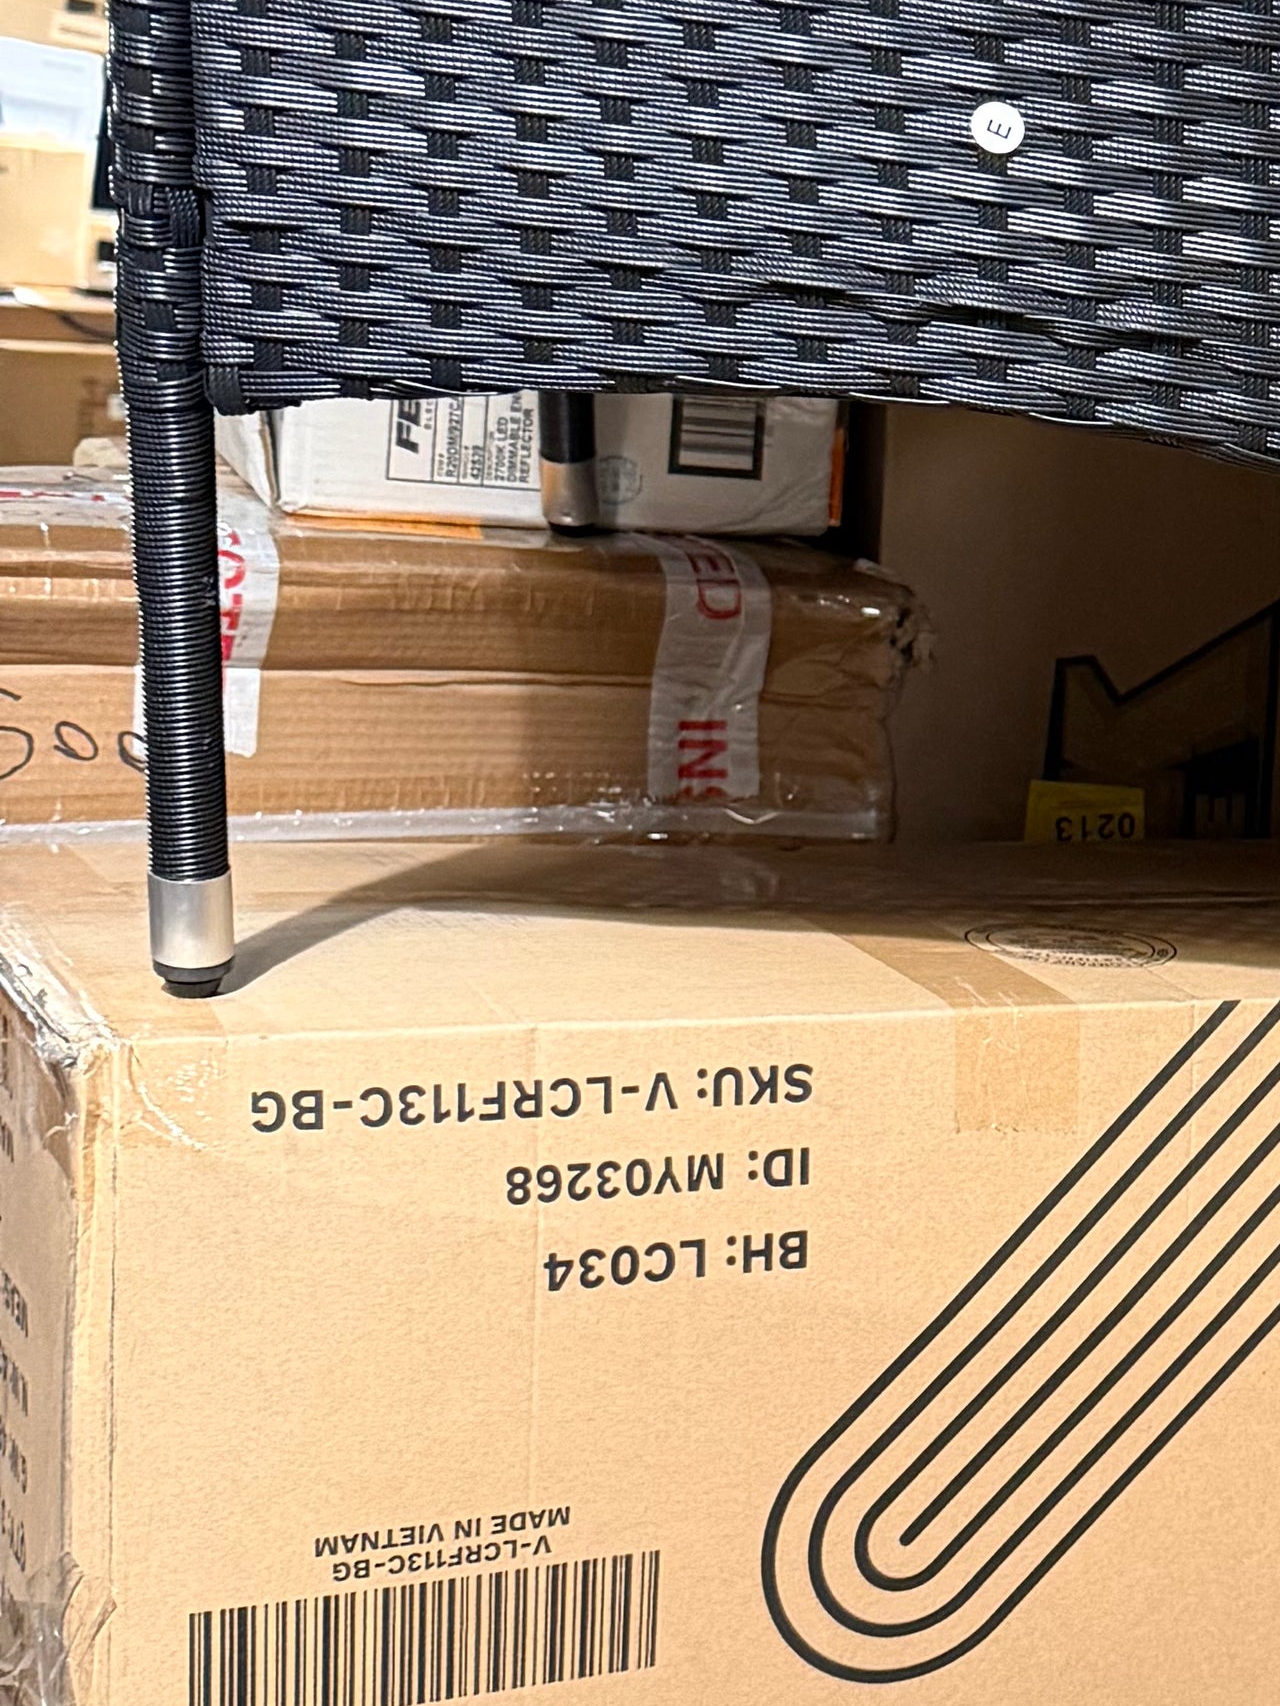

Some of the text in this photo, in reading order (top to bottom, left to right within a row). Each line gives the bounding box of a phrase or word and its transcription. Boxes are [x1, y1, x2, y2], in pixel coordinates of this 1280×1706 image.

[1054, 811, 1136, 842] 0213
[250, 1062, 813, 1133] SKU: V-LCRF113C-BG
[505, 1146, 810, 1206] ID: MY03268
[542, 1228, 808, 1292] BH: LC034
[313, 1504, 571, 1558] MADE IN VIETNAM
[331, 1534, 552, 1582] V-LCRF113C-BG
